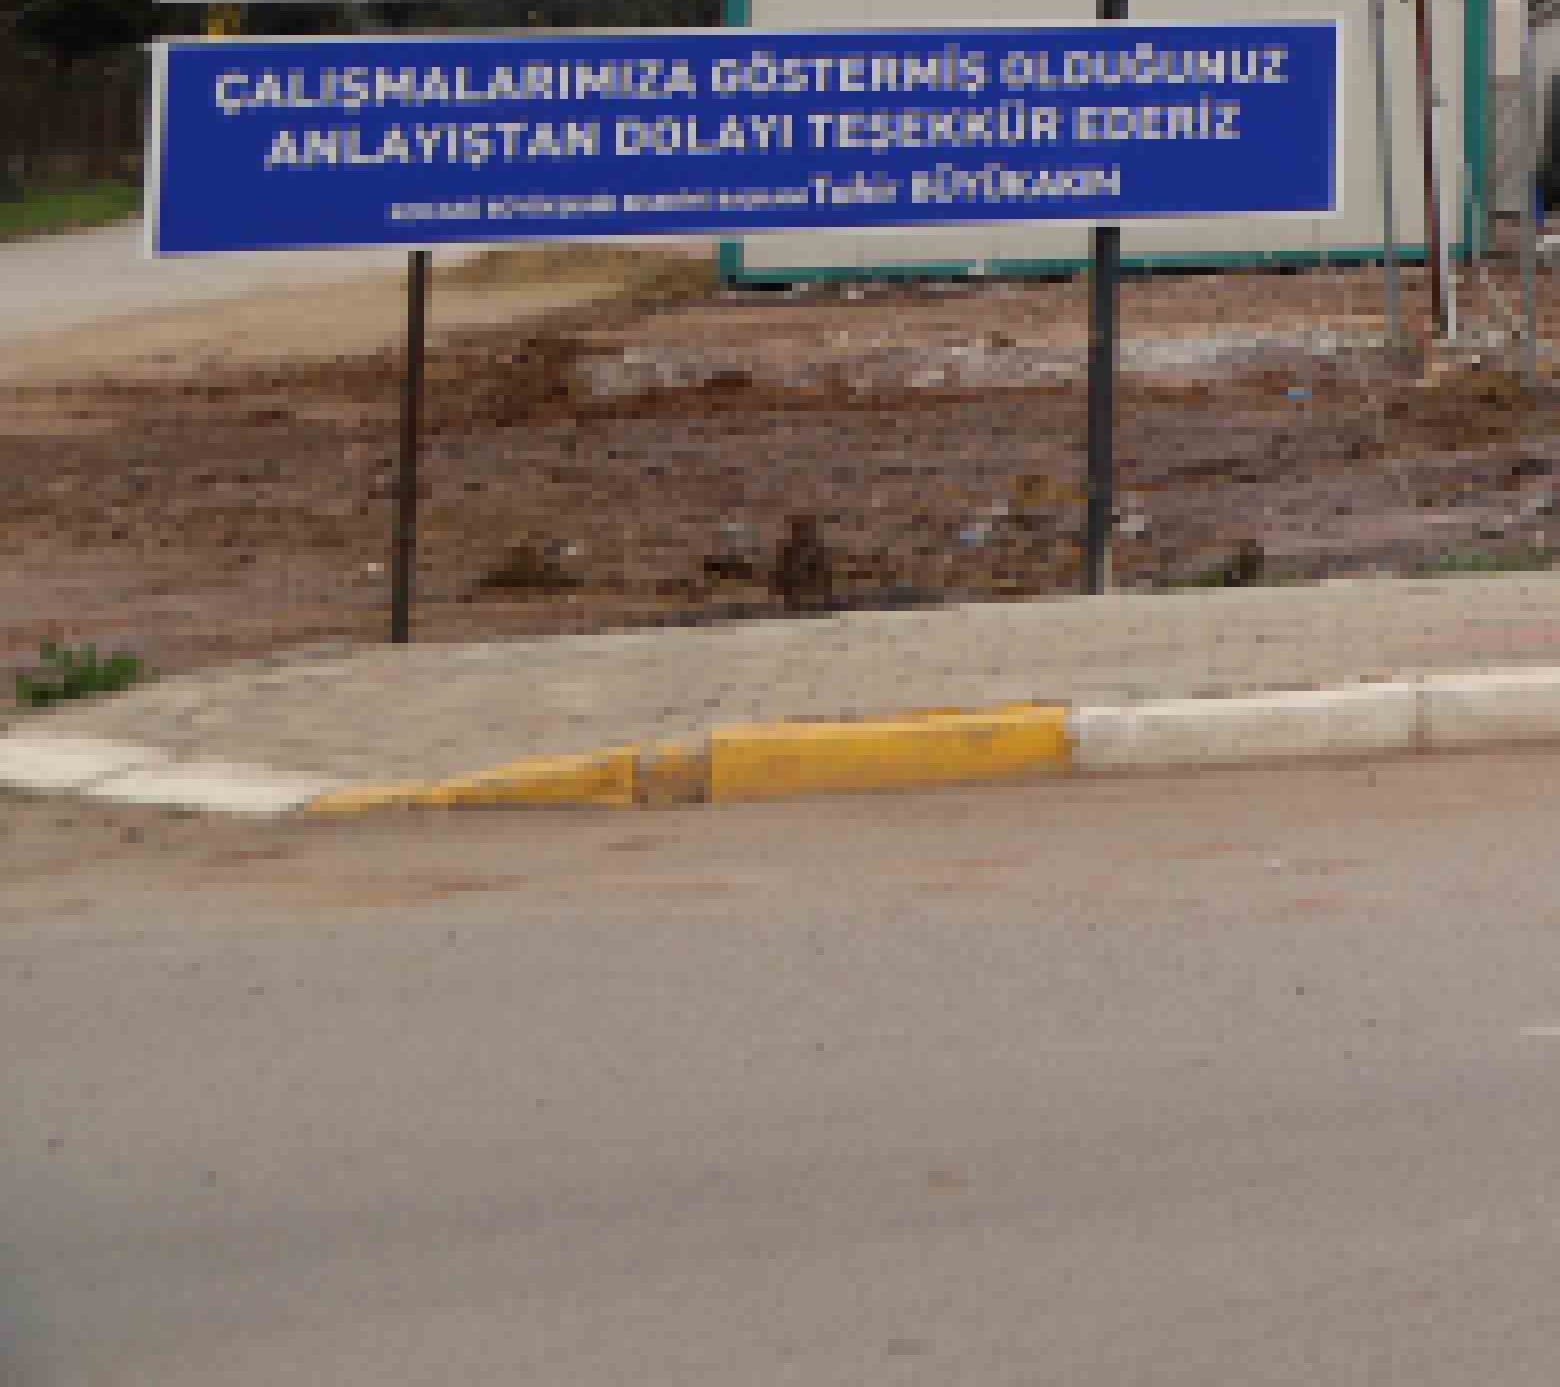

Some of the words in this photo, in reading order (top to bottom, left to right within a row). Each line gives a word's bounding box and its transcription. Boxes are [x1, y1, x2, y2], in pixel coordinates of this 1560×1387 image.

[214, 56, 698, 115] ÇALIŞMALARIMIZA
[263, 116, 603, 172] ANLAYIŞTAN
[614, 110, 794, 158] DOLAYI
